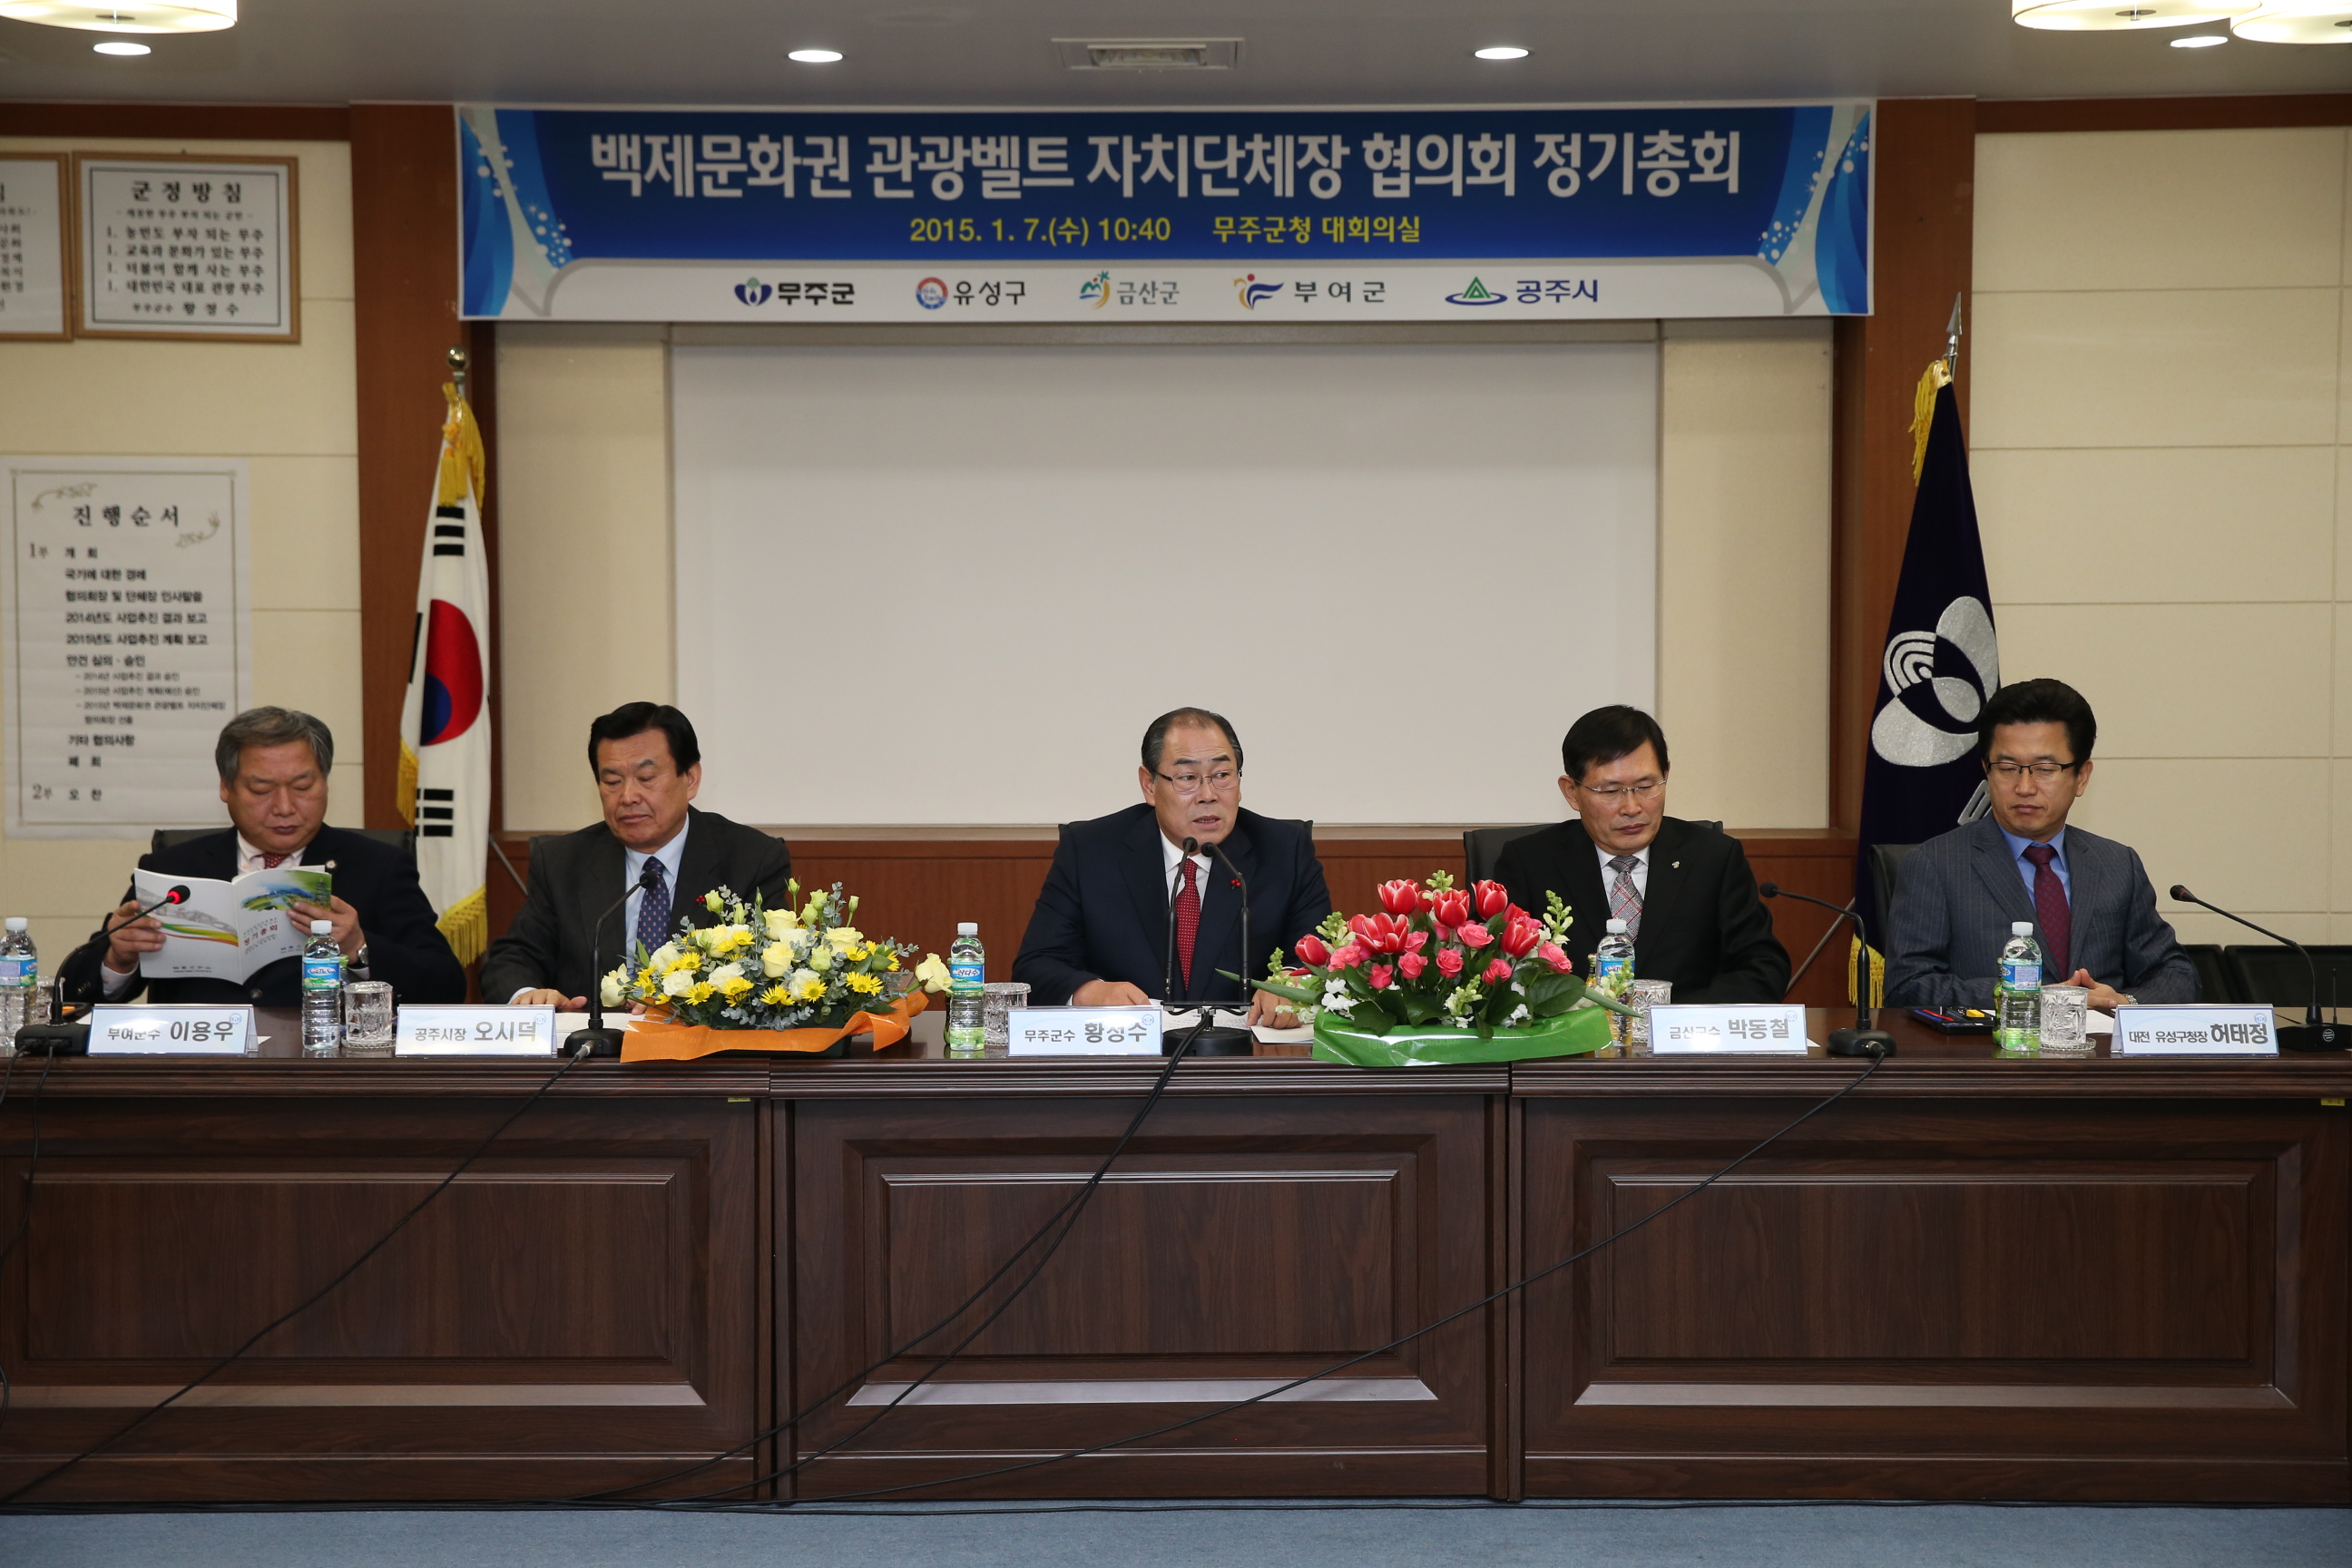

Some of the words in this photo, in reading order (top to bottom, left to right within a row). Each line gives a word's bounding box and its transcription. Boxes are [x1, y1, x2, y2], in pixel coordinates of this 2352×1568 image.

[591, 133, 852, 199] 백제문화권
[865, 134, 1074, 201] 관광벨트
[1086, 132, 1350, 200] 자치단체장
[1362, 132, 1516, 199] 협의회
[1533, 129, 1741, 198] 정기총회
[910, 219, 982, 242] 2015.
[992, 219, 1016, 242] 1.
[1099, 219, 1171, 241] 10:40
[1212, 216, 1312, 244] 무주군청
[1322, 216, 1422, 244] 대회의실
[777, 281, 856, 306] 무주군
[953, 279, 1027, 307] 유성구
[1116, 279, 1181, 306] 금산군
[1293, 279, 1387, 304] 부여군
[1514, 278, 1601, 305] 공주시
[107, 1026, 162, 1041] 부여군수
[170, 1021, 233, 1043] 이용우
[415, 1027, 467, 1042] 공주시장
[474, 1021, 537, 1043] 오시덕
[1024, 1029, 1076, 1043] 무주군수
[1728, 1018, 1790, 1040] 박동철
[2129, 1031, 2151, 1044] 대전
[2155, 1031, 2208, 1044] 유성구청장
[2210, 1023, 2269, 1044] 허태정
